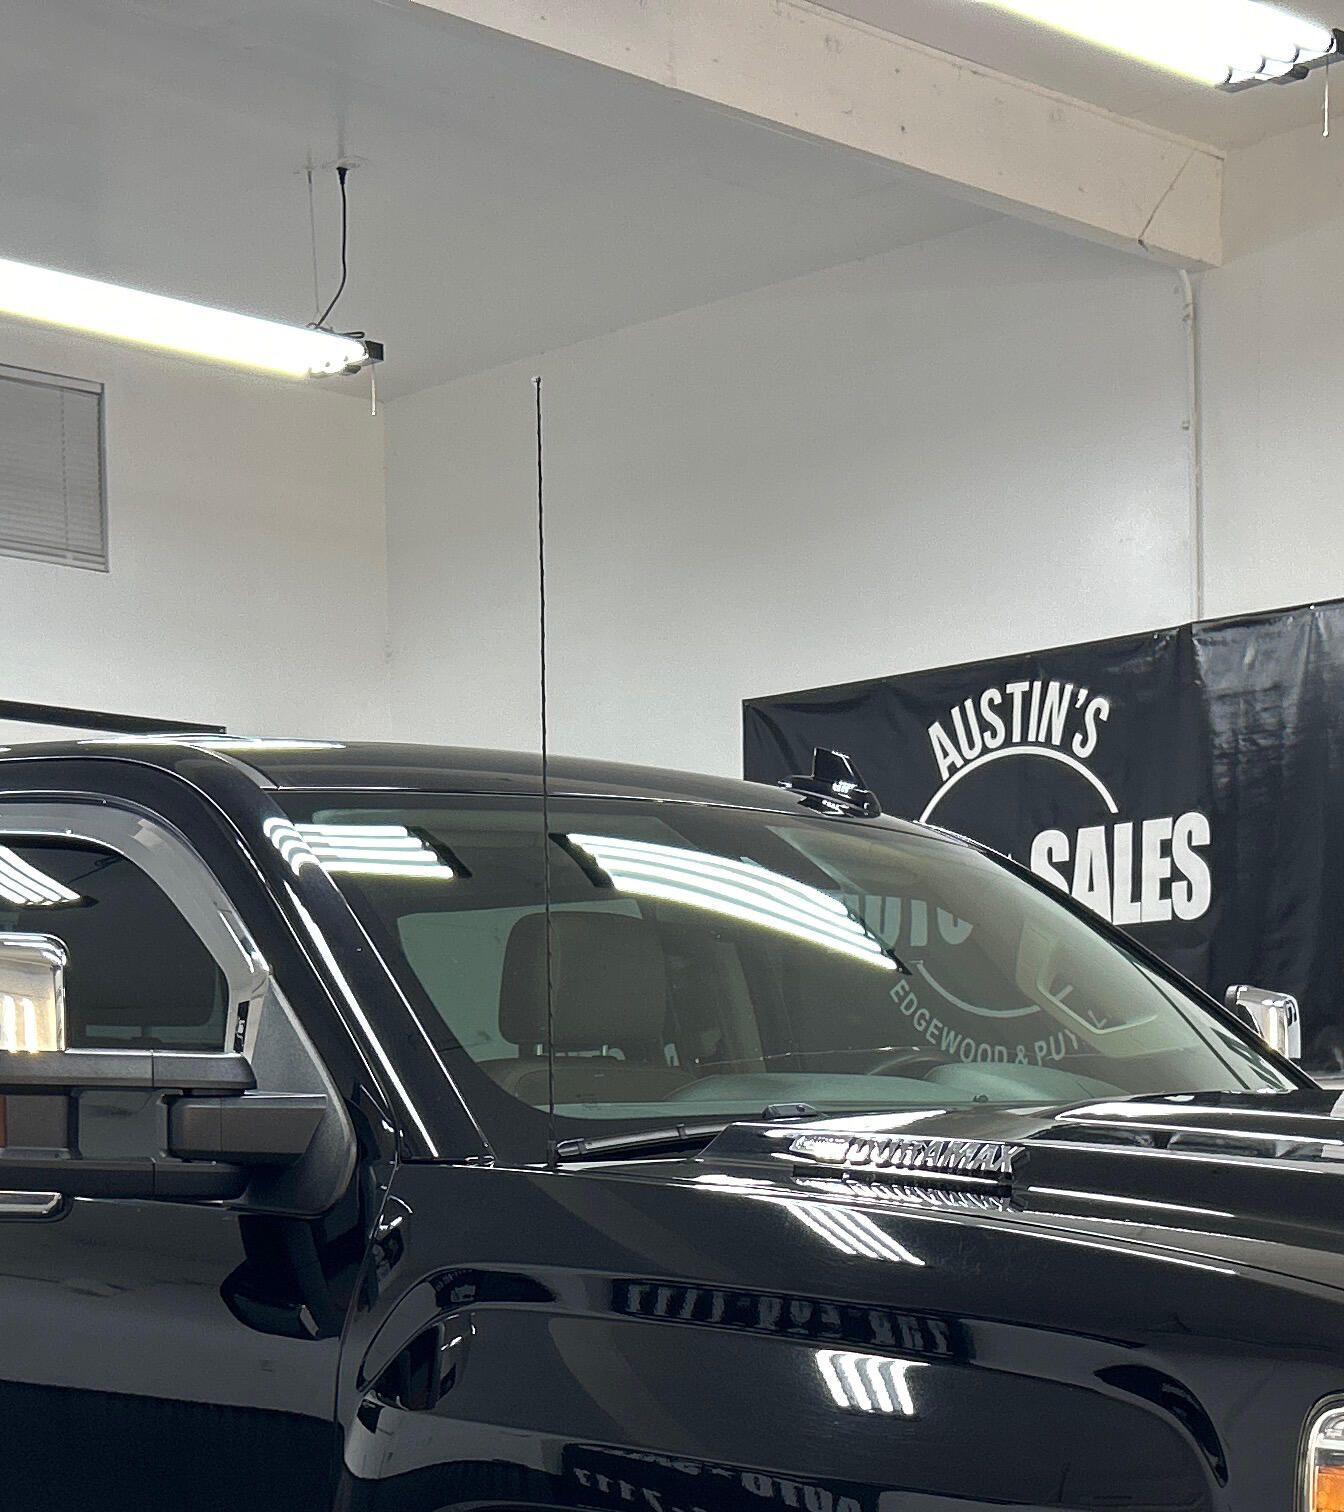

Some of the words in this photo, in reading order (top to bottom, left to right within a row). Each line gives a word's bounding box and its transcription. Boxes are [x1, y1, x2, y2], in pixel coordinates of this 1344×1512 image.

[927, 680, 1111, 782] AUSTIN'S
[1030, 811, 1212, 926] SALES
[889, 979, 1008, 1065] EDGEWOOD
[1016, 1045, 1029, 1065] &
